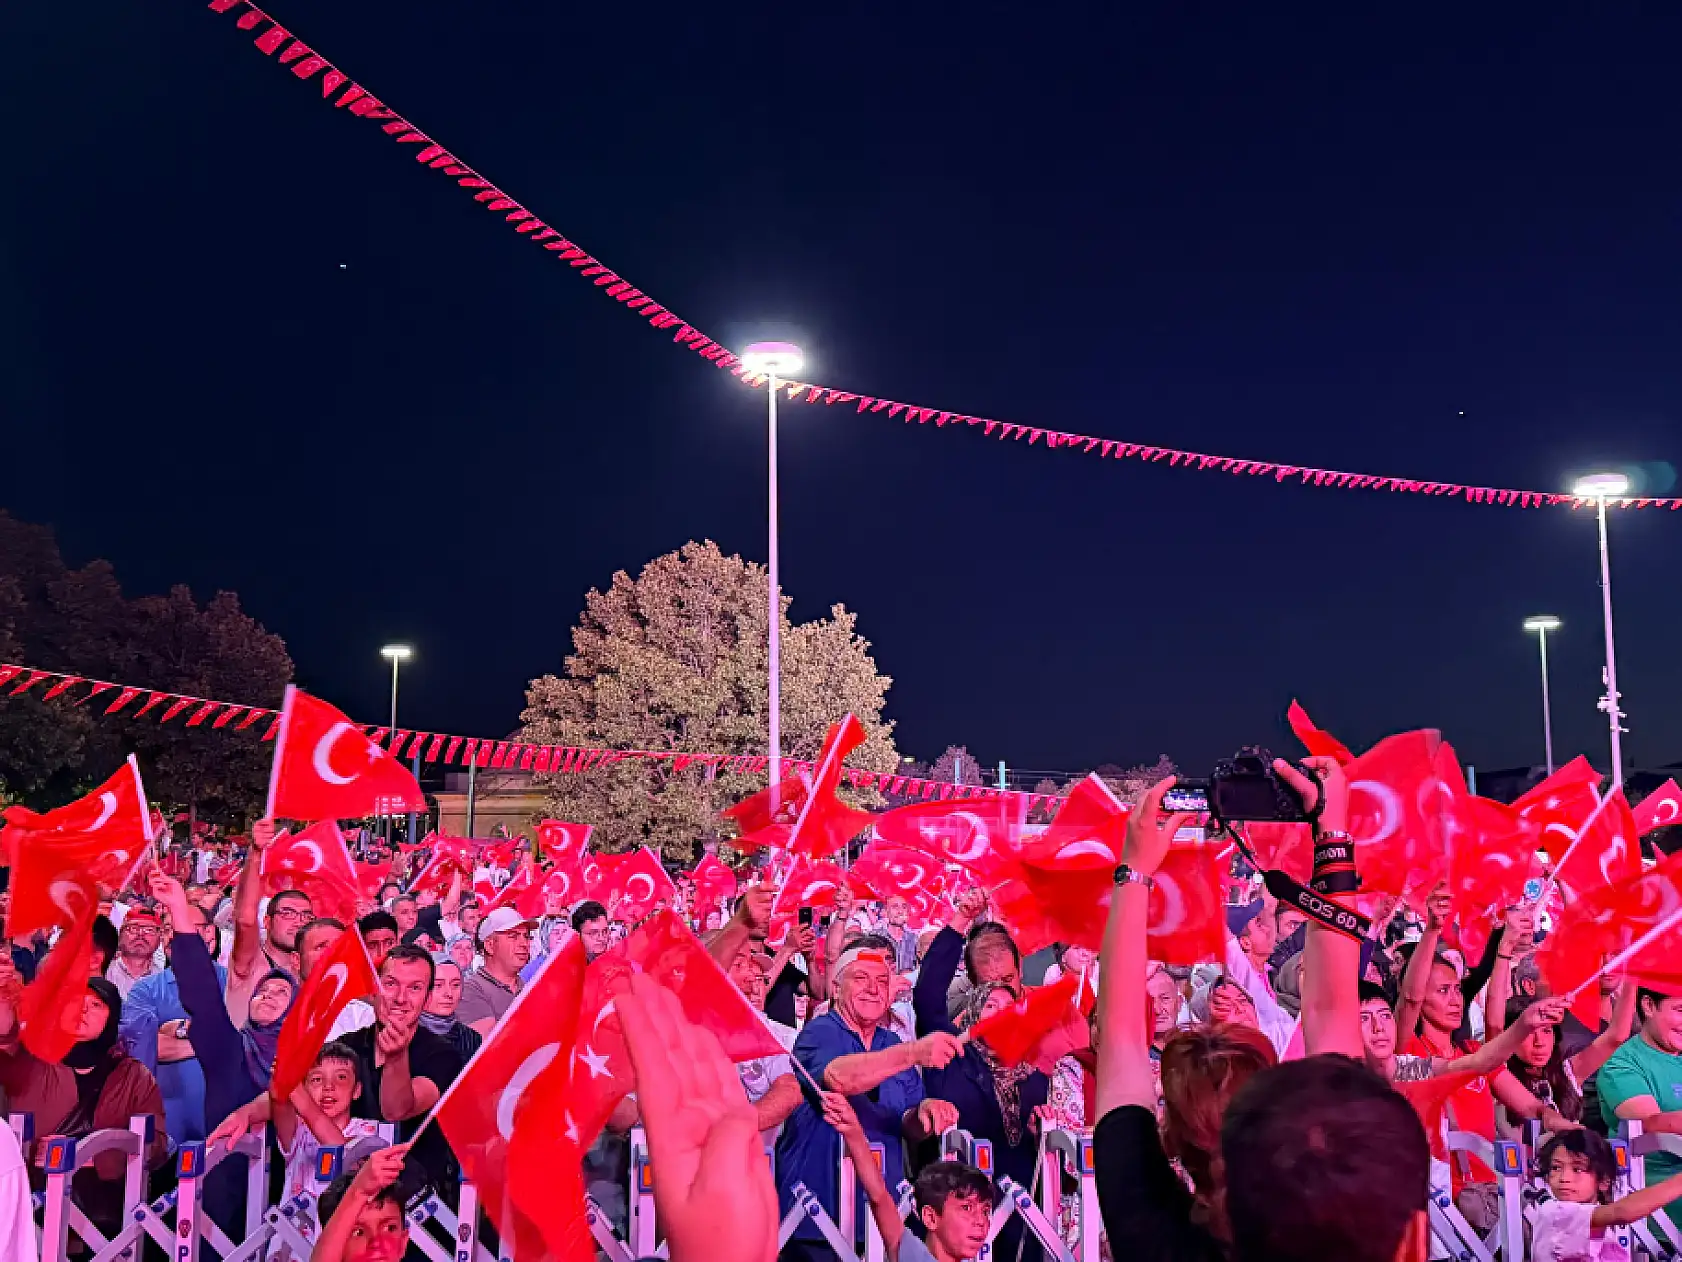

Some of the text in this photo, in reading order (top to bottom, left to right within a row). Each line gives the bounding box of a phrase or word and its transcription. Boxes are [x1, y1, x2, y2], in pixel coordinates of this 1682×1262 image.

[1299, 892, 1357, 930] EOS 6D
[178, 1245, 189, 1262] P
